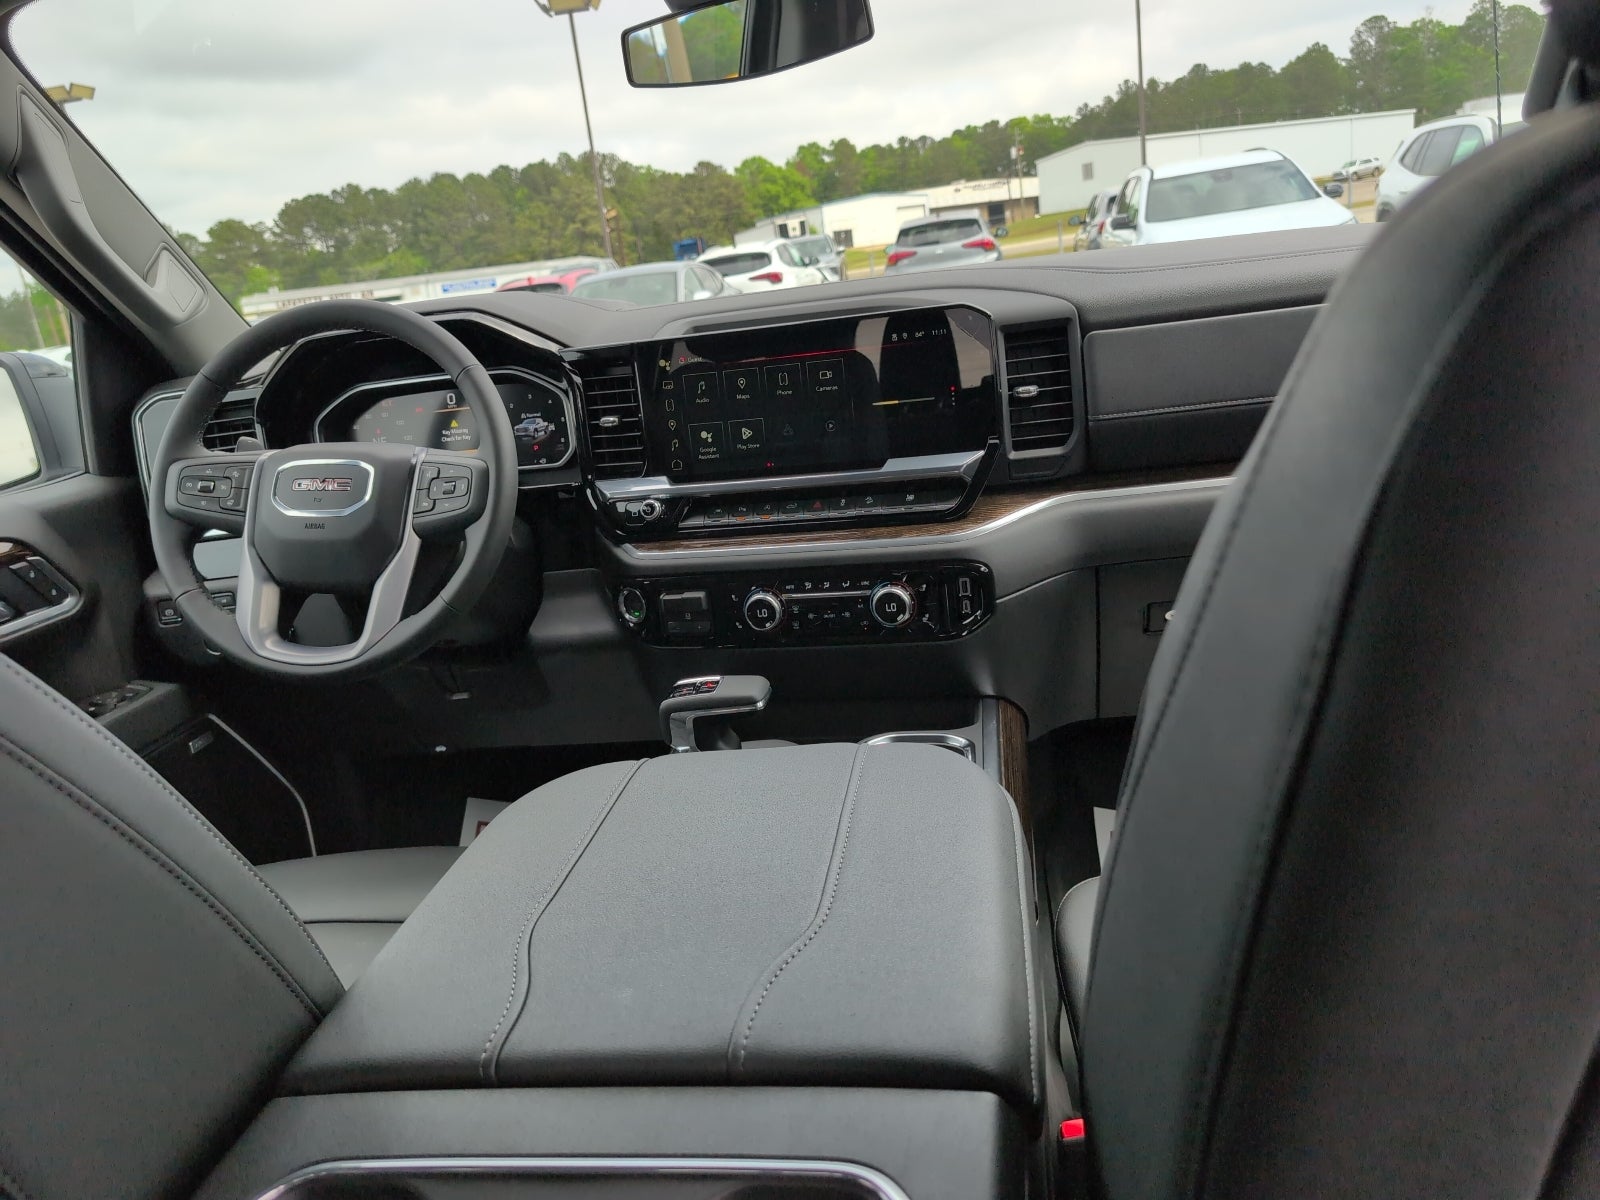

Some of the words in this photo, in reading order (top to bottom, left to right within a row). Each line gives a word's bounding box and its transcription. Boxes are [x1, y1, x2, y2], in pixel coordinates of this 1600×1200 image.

[815, 384, 839, 392] Cameras
[446, 392, 456, 405] 0
[291, 477, 353, 491] GMC
[304, 522, 326, 530] AIRBAG
